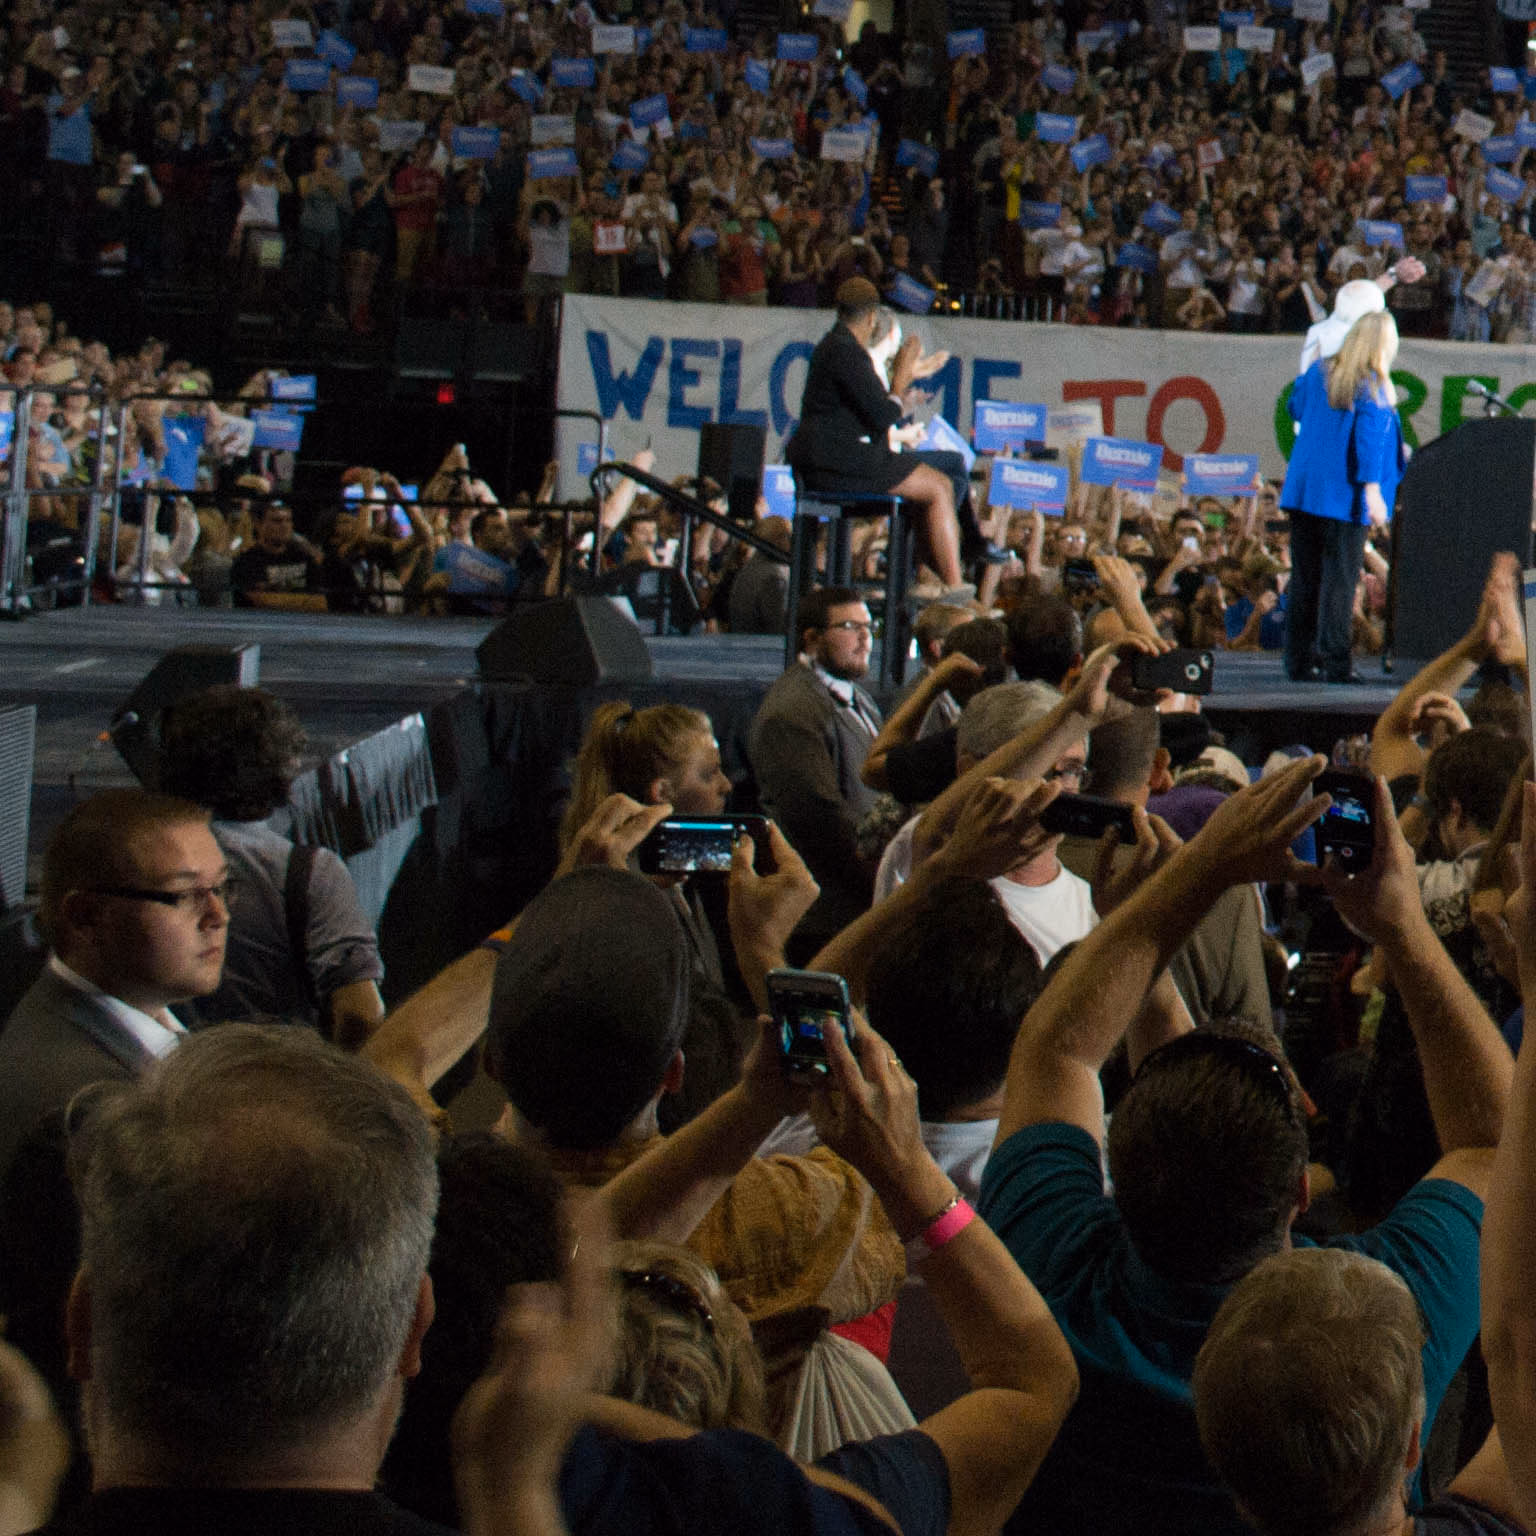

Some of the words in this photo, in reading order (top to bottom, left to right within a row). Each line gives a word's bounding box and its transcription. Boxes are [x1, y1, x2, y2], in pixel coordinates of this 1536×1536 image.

[1062, 375, 1227, 473] TO
[1095, 442, 1153, 468] Bernie
[1002, 464, 1058, 490] Bernie
